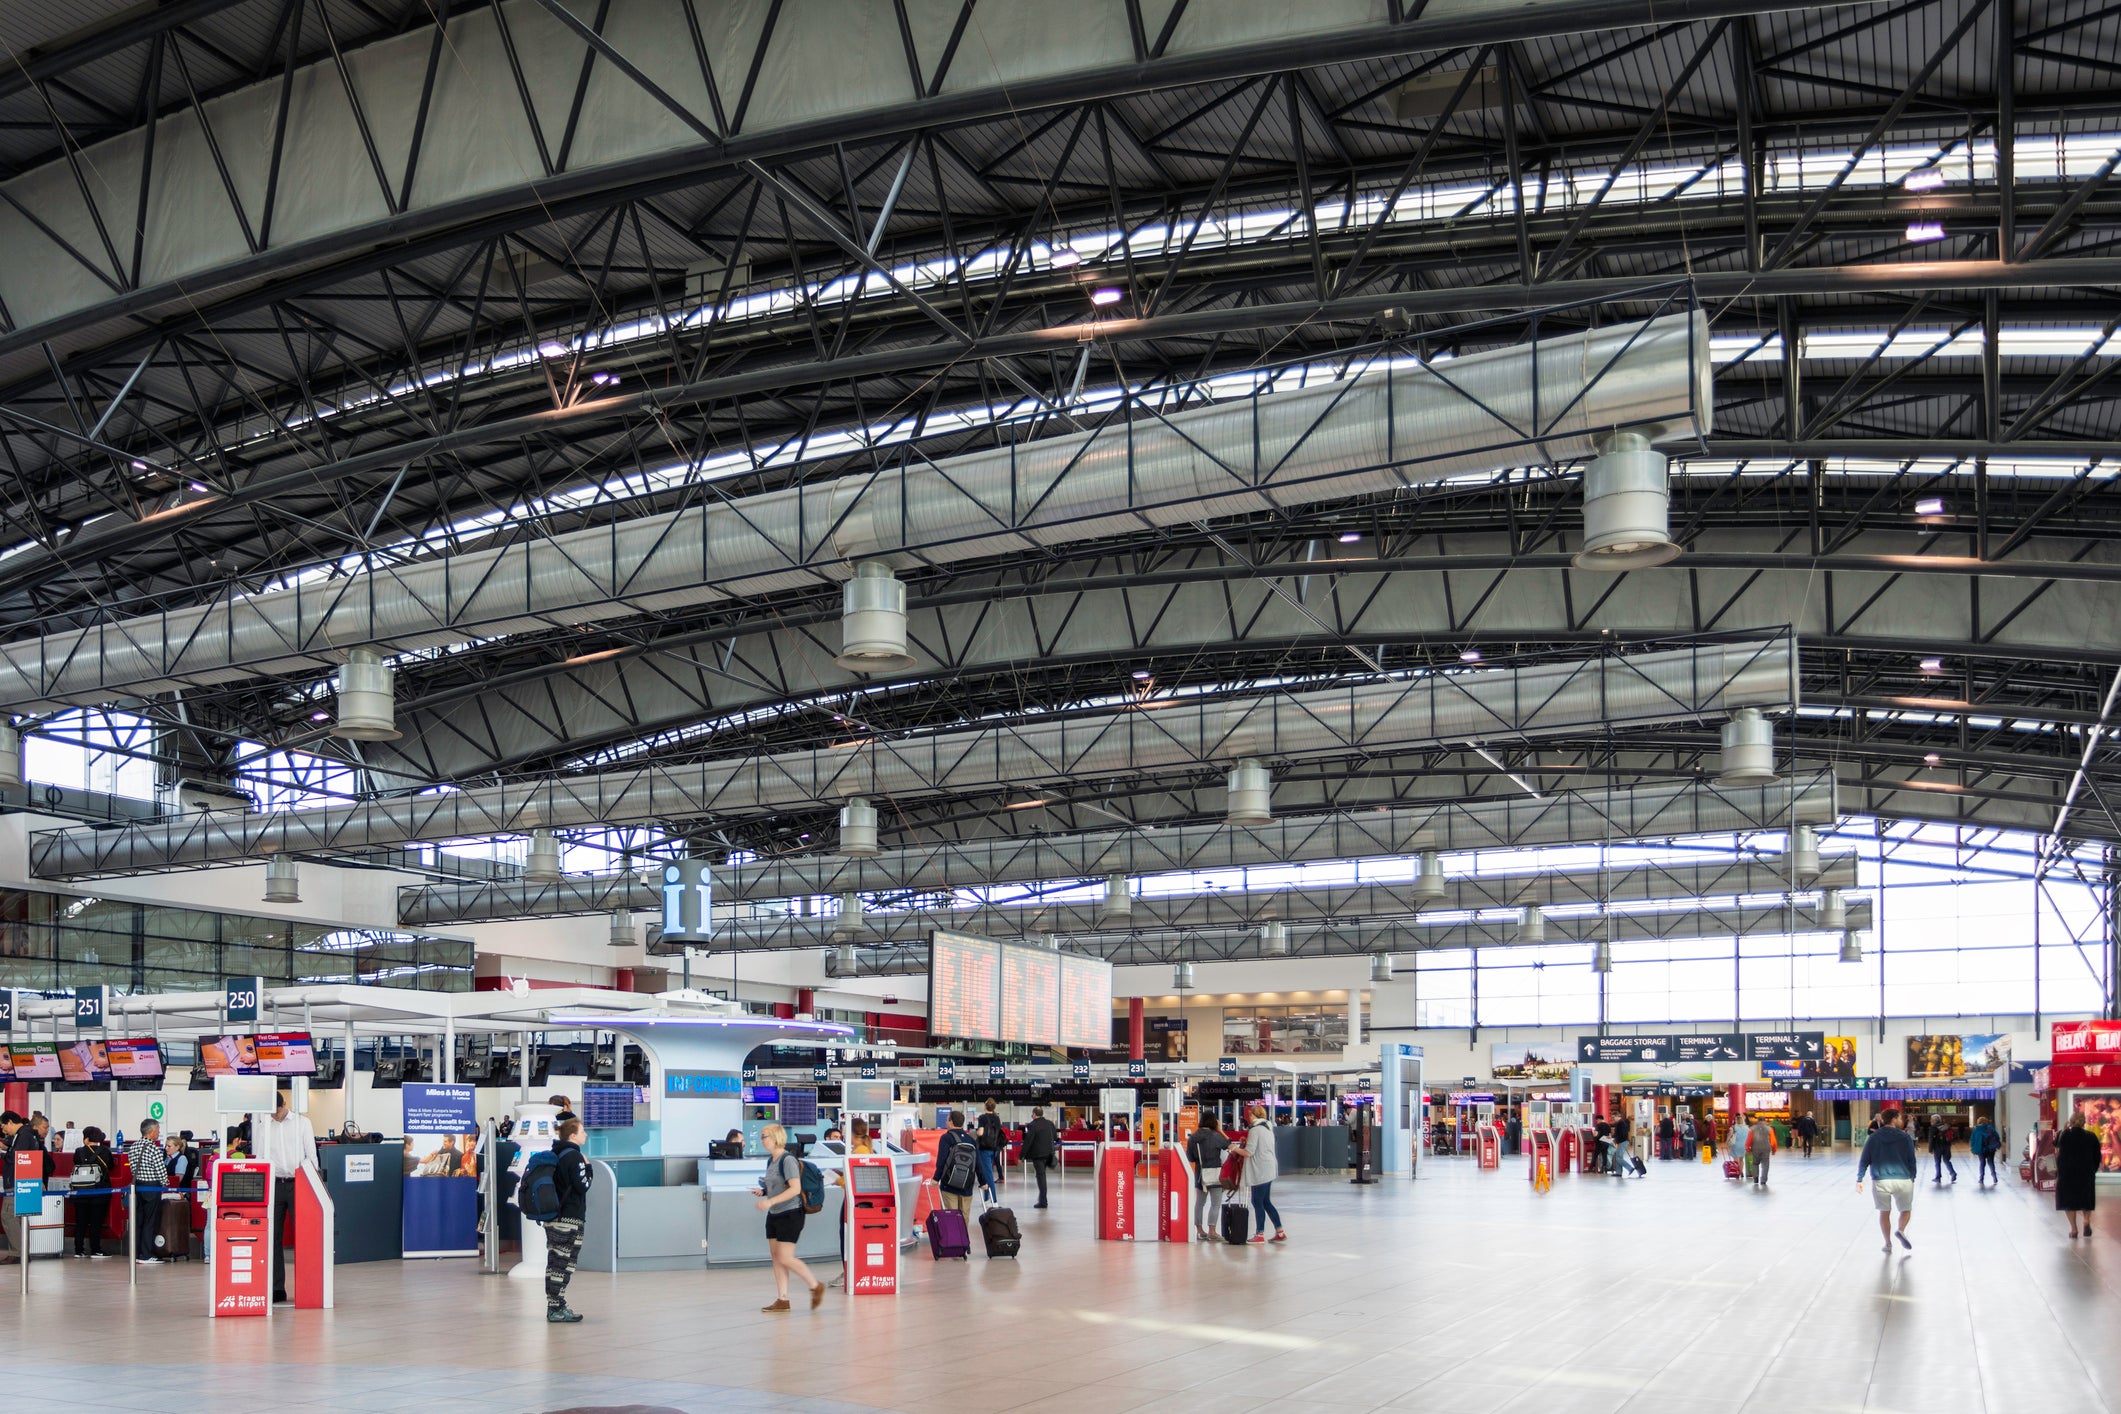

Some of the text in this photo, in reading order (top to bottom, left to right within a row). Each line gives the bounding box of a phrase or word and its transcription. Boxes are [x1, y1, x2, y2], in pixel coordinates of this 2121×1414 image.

[229, 991, 255, 1009] 250
[78, 999, 99, 1015] 251
[1680, 1037, 1716, 1045] TERMINAL
[1754, 1035, 1800, 1043] TERMINAL 2
[2056, 1032, 2086, 1051] RELAY
[37, 1045, 52, 1053] Class
[939, 1067, 952, 1075] 234
[990, 1066, 1004, 1074] 233
[1074, 1065, 1088, 1073] 232
[1131, 1064, 1144, 1072] 231
[1220, 1063, 1235, 1071] 230
[743, 1070, 755, 1078] 237
[814, 1069, 827, 1077] 236
[862, 1068, 875, 1076] 235
[426, 1088, 445, 1096] Miles
[1116, 1171, 1126, 1229] Fly from Prague
